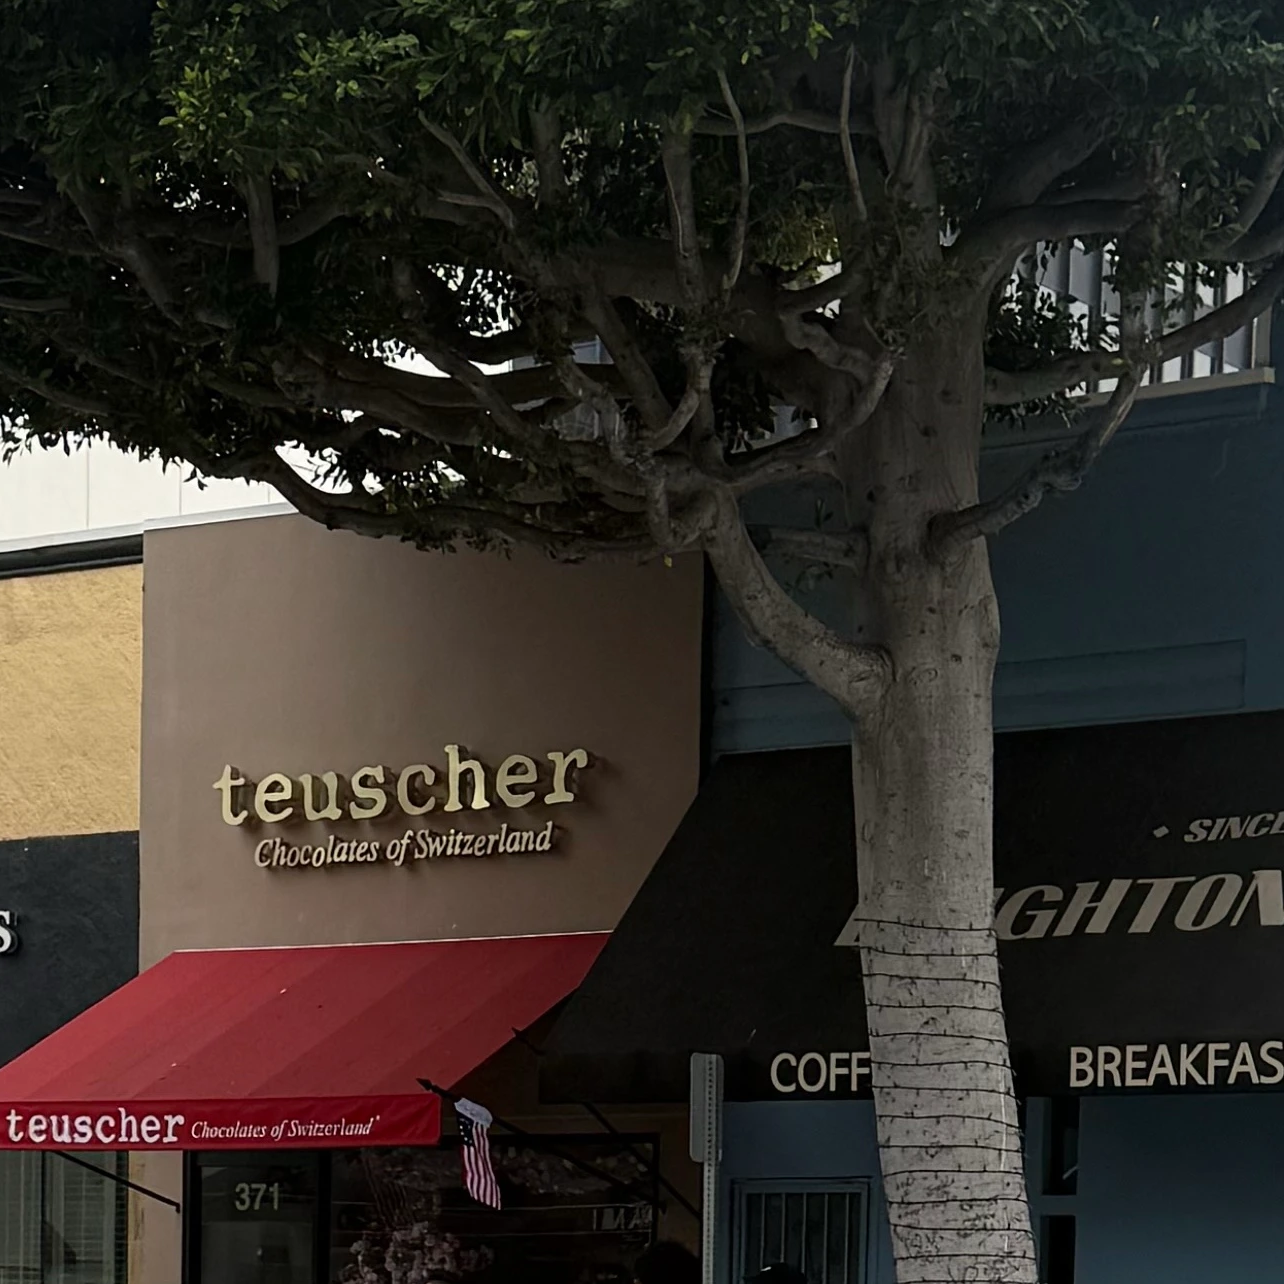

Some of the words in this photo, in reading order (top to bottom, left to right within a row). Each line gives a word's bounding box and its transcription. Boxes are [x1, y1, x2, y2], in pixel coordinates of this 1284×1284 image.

[211, 743, 589, 826] teuscher
[254, 833, 380, 868] Chocolates
[385, 829, 414, 867] of
[415, 820, 554, 859] Switzerland
[770, 1051, 871, 1093] COFF
[5, 1107, 185, 1144] teuscher
[190, 1119, 268, 1140] Chocolates
[269, 1118, 288, 1142] of
[234, 1182, 280, 1211] 371
